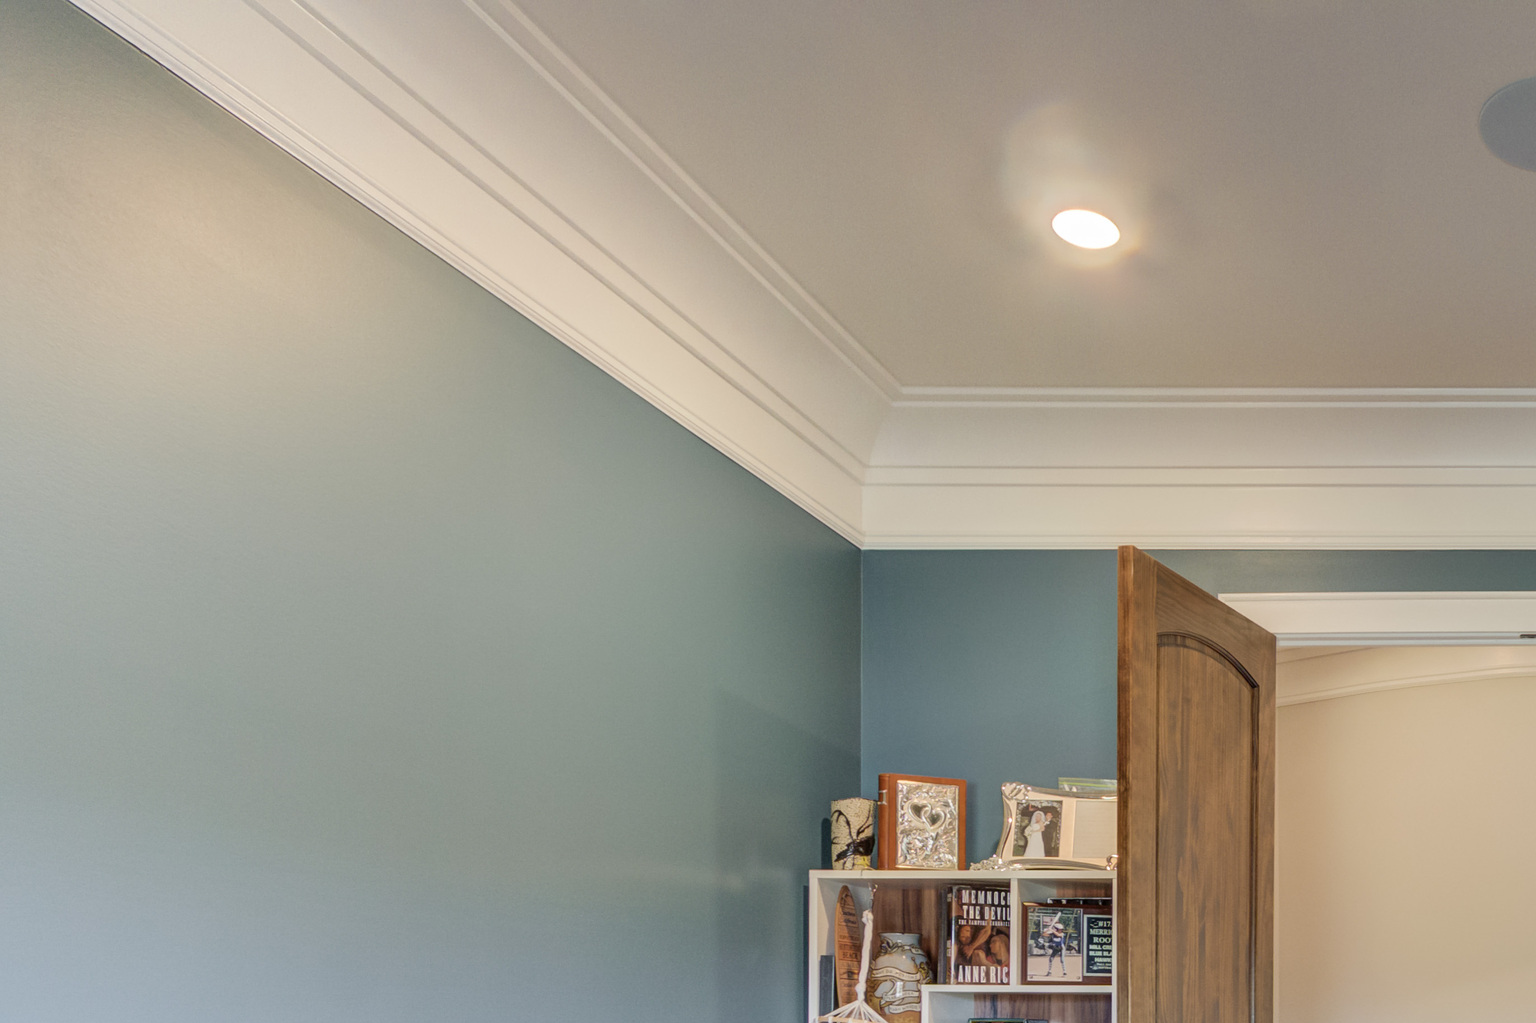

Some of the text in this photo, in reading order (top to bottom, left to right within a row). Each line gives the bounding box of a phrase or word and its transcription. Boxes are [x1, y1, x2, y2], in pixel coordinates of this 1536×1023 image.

[962, 905, 980, 919] THE
[958, 965, 1008, 984] ANNE RIC
